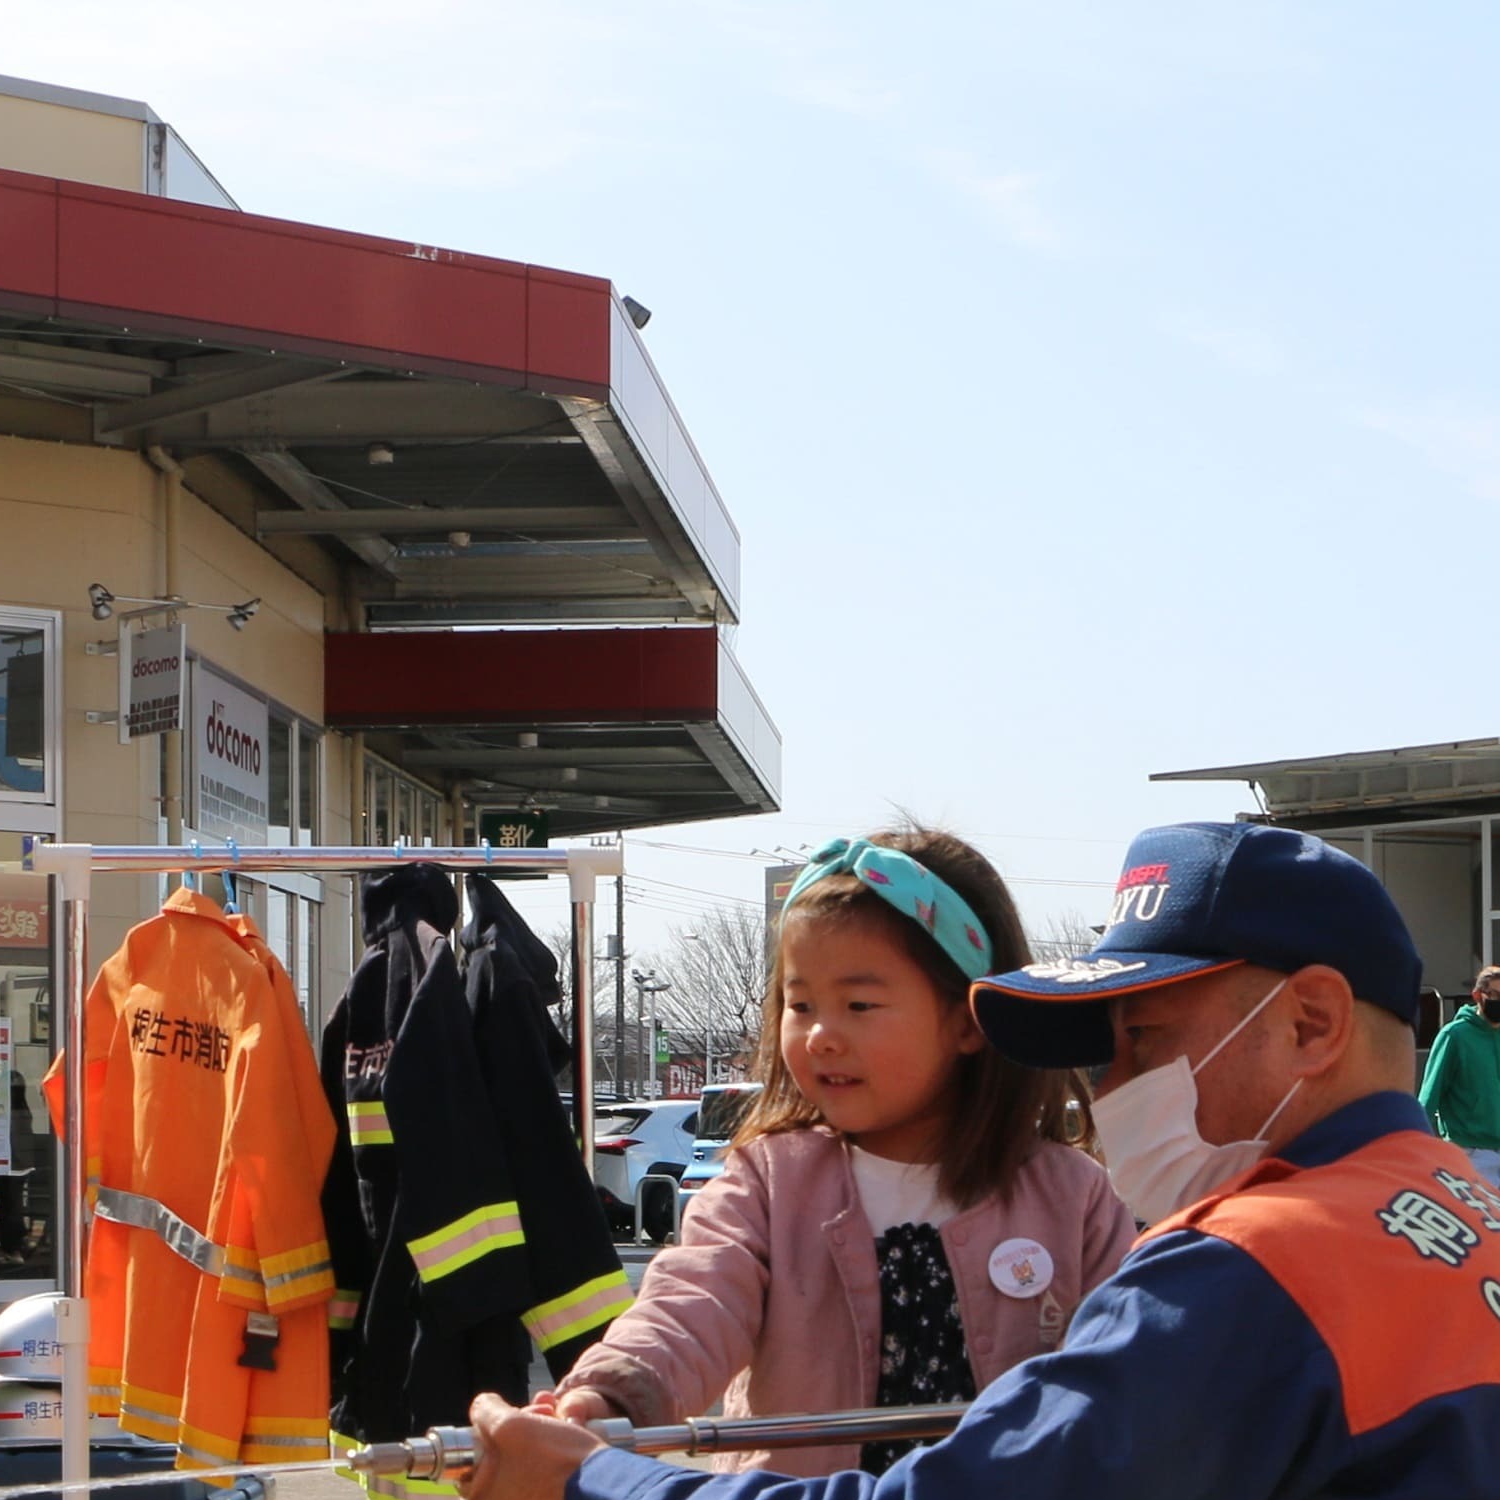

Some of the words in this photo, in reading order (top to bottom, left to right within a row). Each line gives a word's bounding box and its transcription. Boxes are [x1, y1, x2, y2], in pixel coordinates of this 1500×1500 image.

[132, 654, 180, 679] docomo
[206, 700, 262, 778] docomo
[656, 1035, 668, 1052] 15
